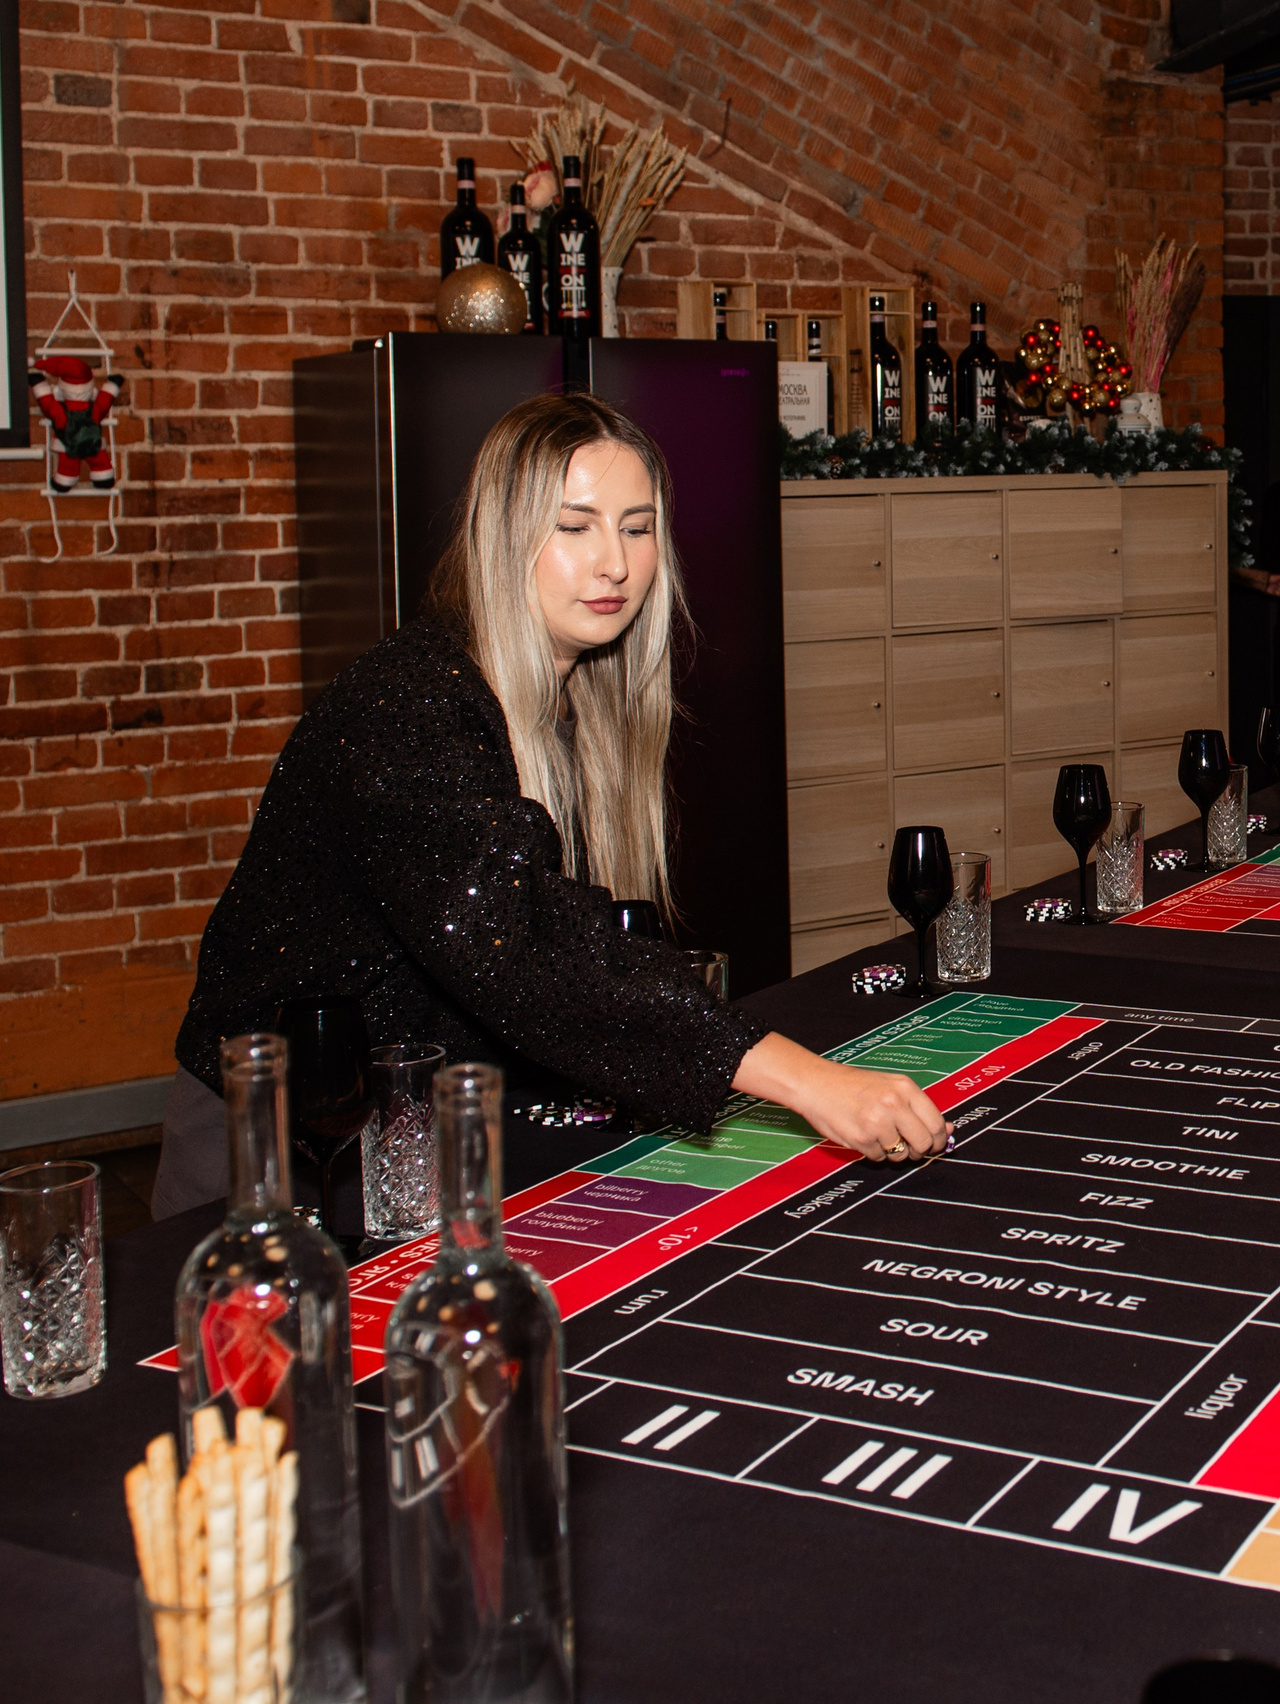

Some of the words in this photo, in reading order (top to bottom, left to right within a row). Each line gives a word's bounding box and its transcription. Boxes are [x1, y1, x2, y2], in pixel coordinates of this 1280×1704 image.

[455, 236, 480, 256] W
[560, 233, 584, 252] W
[507, 254, 529, 271] W
[560, 254, 585, 266] INE
[511, 272, 530, 283] NE
[561, 274, 584, 286] ON
[928, 376, 947, 392] W
[928, 394, 948, 404] INE
[1124, 1011, 1156, 1021] any
[1159, 1014, 1195, 1023] time
[1067, 1041, 1103, 1061] other
[1130, 1059, 1185, 1071] OLD
[1216, 1096, 1280, 1111] FLIP
[1181, 1126, 1240, 1141] TINI
[649, 1157, 688, 1168] other
[1080, 1153, 1251, 1180] SMOOTHIE
[594, 1182, 651, 1197] bilberry
[784, 1177, 865, 1220] whiskey
[1079, 1191, 1154, 1210] FIZZ
[534, 1210, 605, 1226] blueberry
[1000, 1227, 1126, 1254] SPRITZ
[861, 1258, 1026, 1291] NEGRONI
[1027, 1281, 1147, 1311] STYLE
[613, 1288, 669, 1315] rum
[879, 1317, 990, 1346] SOUR
[786, 1367, 935, 1406] SMASH
[1184, 1373, 1248, 1420] liquor
[620, 1403, 721, 1451] II
[820, 1440, 953, 1499] III
[1052, 1482, 1203, 1544] IV
